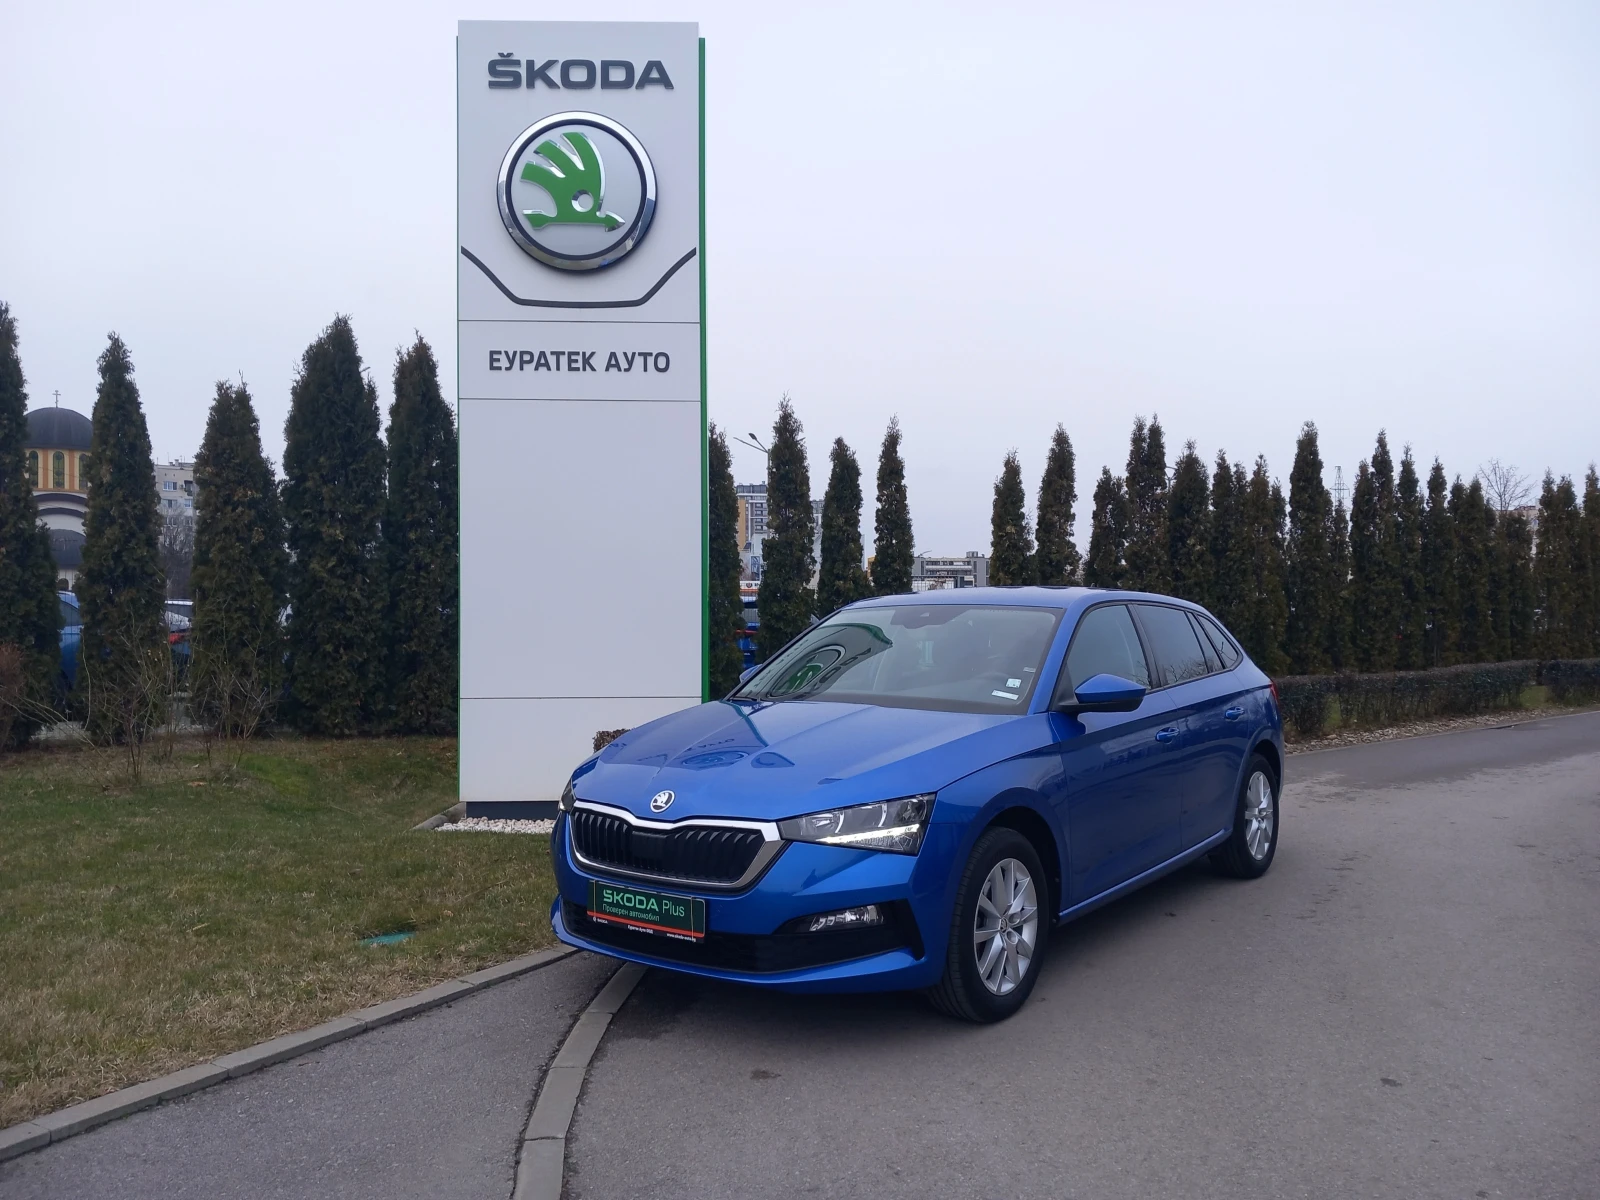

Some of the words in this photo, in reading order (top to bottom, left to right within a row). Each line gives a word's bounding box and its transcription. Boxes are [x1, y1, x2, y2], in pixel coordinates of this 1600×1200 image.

[487, 52, 675, 90] ŠKODA
[489, 350, 597, 372] ЕУРАТЕК
[604, 351, 671, 373] АУТО
[602, 903, 629, 916] Проверен
[662, 900, 685, 917] Plus
